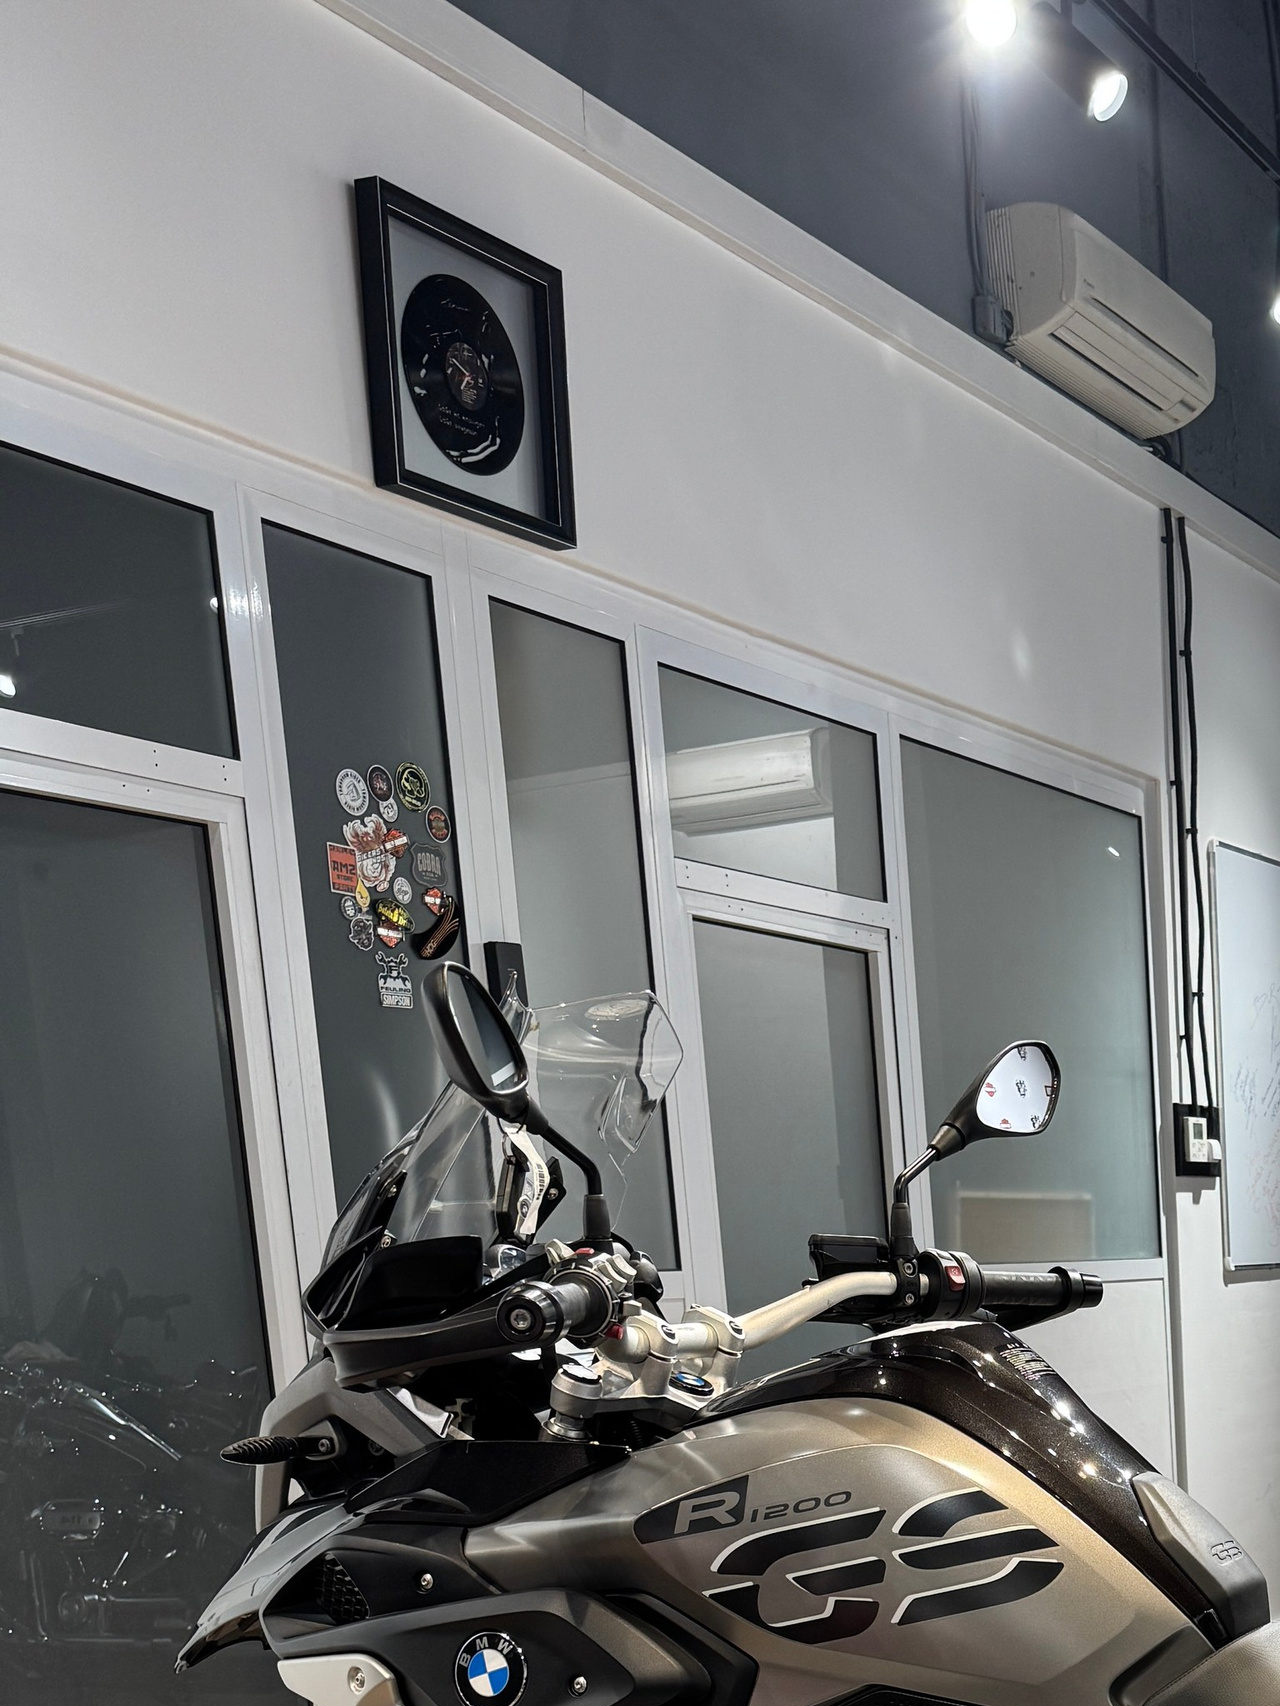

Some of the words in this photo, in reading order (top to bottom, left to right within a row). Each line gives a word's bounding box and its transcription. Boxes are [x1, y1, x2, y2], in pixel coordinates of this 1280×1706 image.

[417, 852, 441, 876] COBRA
[383, 994, 411, 1006] SIMPSON
[673, 1490, 742, 1535] R
[749, 1490, 852, 1524] 1200
[702, 1487, 1066, 1645] GS
[459, 1636, 514, 1668] BMW
